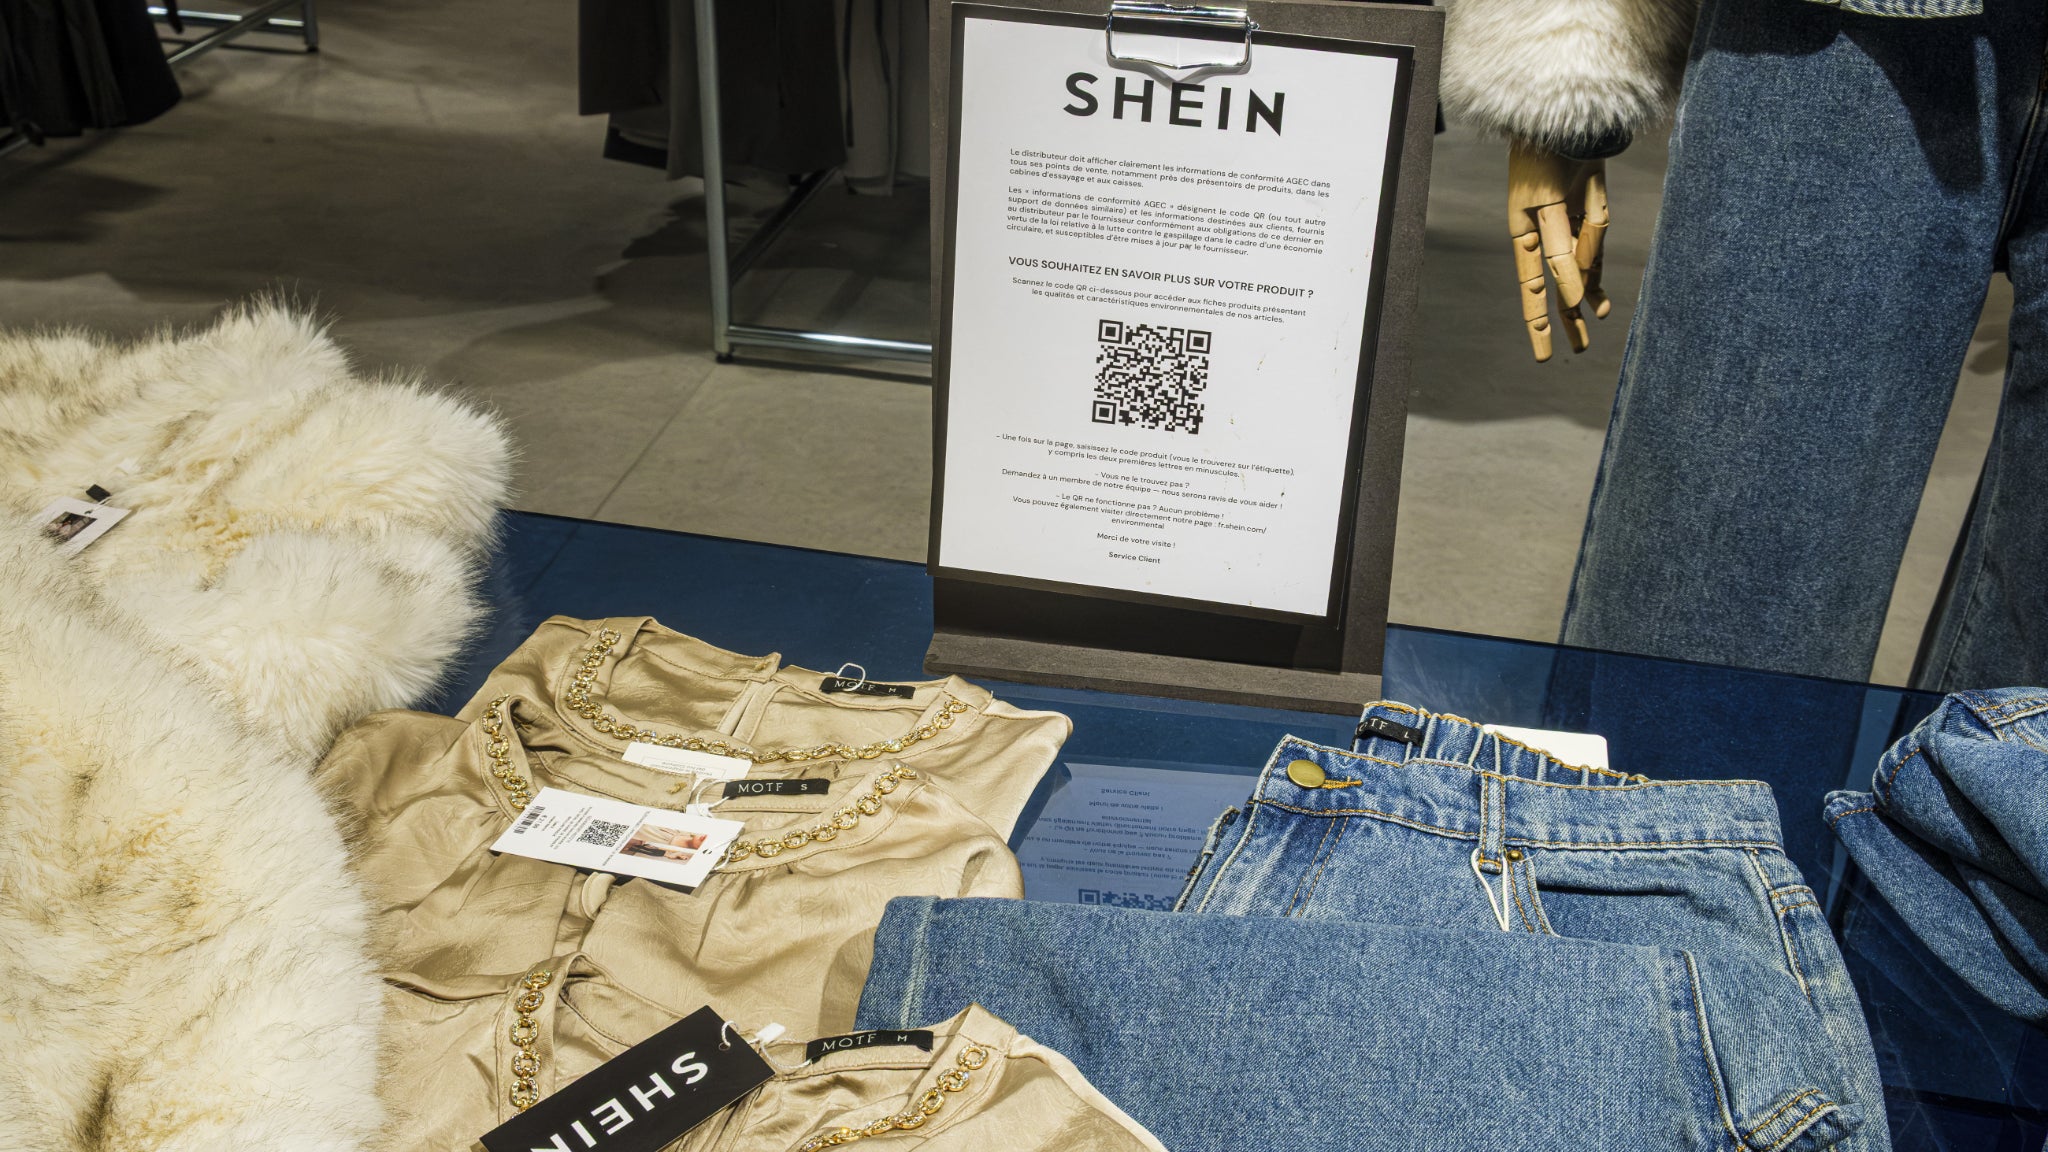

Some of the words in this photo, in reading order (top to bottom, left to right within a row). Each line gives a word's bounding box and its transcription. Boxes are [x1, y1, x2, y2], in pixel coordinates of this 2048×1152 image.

[1063, 72, 1285, 136] SHEIN
[1009, 168, 1040, 177] cabines
[1010, 148, 1020, 156] Le
[1021, 149, 1068, 161] distributeur
[1069, 155, 1086, 163] doit
[1086, 156, 1118, 166] afficher
[1118, 159, 1161, 171] clairement
[1162, 163, 1175, 172] les
[1176, 165, 1226, 177] informations
[1239, 173, 1285, 183] conformité
[1285, 177, 1310, 186] AGEC
[1310, 179, 1331, 189] dans
[1010, 158, 1028, 166] tous
[1045, 162, 1071, 171] points
[1111, 169, 1158, 180] notamment
[1159, 174, 1178, 182] près
[1179, 175, 1195, 184] des
[1196, 177, 1243, 189] présentoirs
[1295, 188, 1316, 197] dans
[1317, 190, 1330, 198] les
[1008, 185, 1022, 194] Les
[1032, 188, 1082, 201] informations
[1097, 196, 1141, 207] conformité
[1143, 200, 1167, 209] AGEC
[1176, 203, 1217, 215] désignent
[1229, 210, 1250, 218] code
[1253, 211, 1266, 220] QR
[1284, 216, 1302, 224] tout
[1304, 218, 1327, 227] autre
[1008, 196, 1039, 205] support
[1054, 200, 1089, 211] données
[1140, 209, 1152, 217] les
[1154, 211, 1205, 223] informations
[1206, 216, 1246, 227] destinées
[1297, 226, 1325, 236] fournis
[1006, 215, 1028, 223] vertu
[1049, 218, 1059, 226] loi
[1060, 220, 1090, 229] relative
[1106, 224, 1125, 233] lutte
[1126, 228, 1153, 236] contre
[1163, 232, 1203, 243] gaspillage
[1204, 235, 1224, 244] dans
[1234, 239, 1258, 247] cadre
[1283, 244, 1323, 255] économie
[1018, 206, 1065, 217] distributeur
[1090, 213, 1135, 225] fournisseur
[1136, 219, 1195, 231] conformément
[1213, 227, 1257, 238] obligations
[1282, 234, 1312, 244] dernier
[1055, 229, 1105, 240] susceptibles
[1130, 237, 1154, 246] mises
[1161, 240, 1178, 249] jour
[1008, 255, 1039, 268] VOUS
[1040, 259, 1102, 275] SOUHAITEZ
[1104, 266, 1120, 277] EN
[1121, 268, 1162, 282] SAVOIR
[1163, 273, 1191, 285] PLUS
[1193, 276, 1216, 288] SUR
[1217, 279, 1255, 292] VOTRE
[1256, 283, 1306, 298] PRODUIT
[1012, 276, 1045, 287] Scannez
[1054, 282, 1075, 291] code
[1075, 284, 1088, 292] QR
[1088, 285, 1132, 297] ci-dessous
[1153, 294, 1187, 303] accéder
[1203, 298, 1227, 308] fiches
[1228, 302, 1262, 312] produits
[1262, 306, 1306, 317] présentant
[1031, 288, 1043, 296] les
[1044, 291, 1075, 300] qualités
[1086, 295, 1149, 308] caractéristiques
[1150, 302, 1224, 316] environnementales
[1002, 433, 1017, 442] Une
[1018, 435, 1032, 443] fois
[1076, 444, 1109, 453] saisissez
[1119, 449, 1139, 457] code
[1139, 451, 1168, 460] produit
[1200, 458, 1236, 469] trouverez
[1054, 450, 1085, 459] compris
[1086, 452, 1098, 460] les
[1098, 454, 1118, 463] deux
[1118, 458, 1157, 468] premières
[1158, 461, 1183, 471] lettres
[1001, 468, 1041, 480] Demandez
[1059, 476, 1091, 486] membre
[1103, 482, 1124, 490] notre
[1125, 483, 1152, 494] équipe
[1161, 489, 1180, 497] nous
[1181, 492, 1207, 500] serons
[1208, 495, 1227, 503] ravis
[1258, 500, 1278, 509] aider
[1100, 471, 1120, 480] Vous
[1140, 477, 1168, 487] trouvez
[1012, 495, 1031, 504] Vous
[1032, 499, 1059, 508] pouvez
[1059, 501, 1099, 513] également
[1100, 507, 1124, 516] visiter
[1125, 510, 1171, 522] directement
[1172, 517, 1193, 525] notre
[1193, 519, 1213, 528] page
[1061, 493, 1071, 501] Le
[1072, 494, 1084, 502] QR
[1095, 497, 1136, 509] fonctionne
[1136, 503, 1151, 511] pas
[1158, 505, 1183, 514] Aucun
[1183, 509, 1220, 519] problème
[1096, 532, 1118, 542] Merci
[1130, 537, 1150, 546] votre
[1151, 539, 1172, 548] visite
[1111, 518, 1165, 530] environmental
[1108, 551, 1137, 561] Service
[1137, 554, 1161, 565] Client
[738, 782, 784, 793] MOTF
[800, 783, 808, 791] S
[822, 1033, 877, 1051] MOTF
[897, 1034, 908, 1042] M
